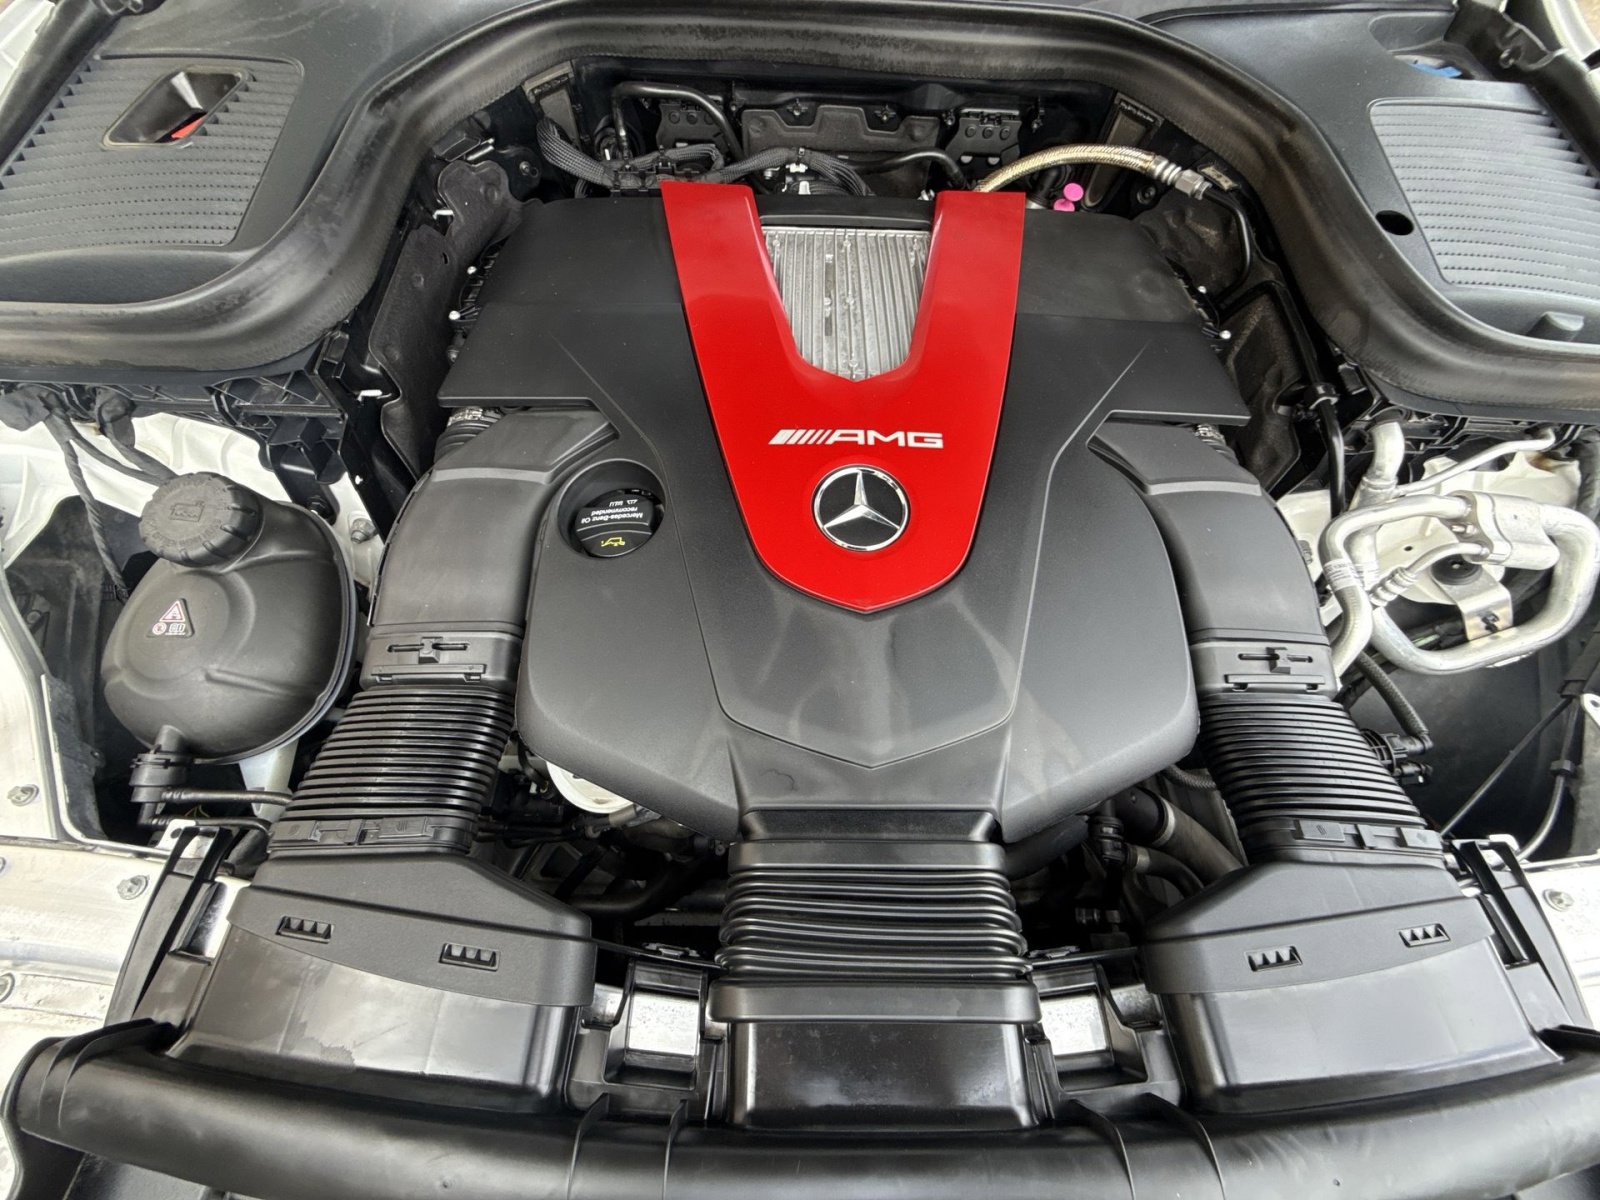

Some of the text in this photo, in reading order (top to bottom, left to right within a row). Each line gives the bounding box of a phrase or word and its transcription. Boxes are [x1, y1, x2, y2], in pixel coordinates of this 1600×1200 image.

[824, 429, 944, 449] AMG
[591, 507, 638, 516] recommended
[592, 512, 644, 522] Mercedes-Benz
